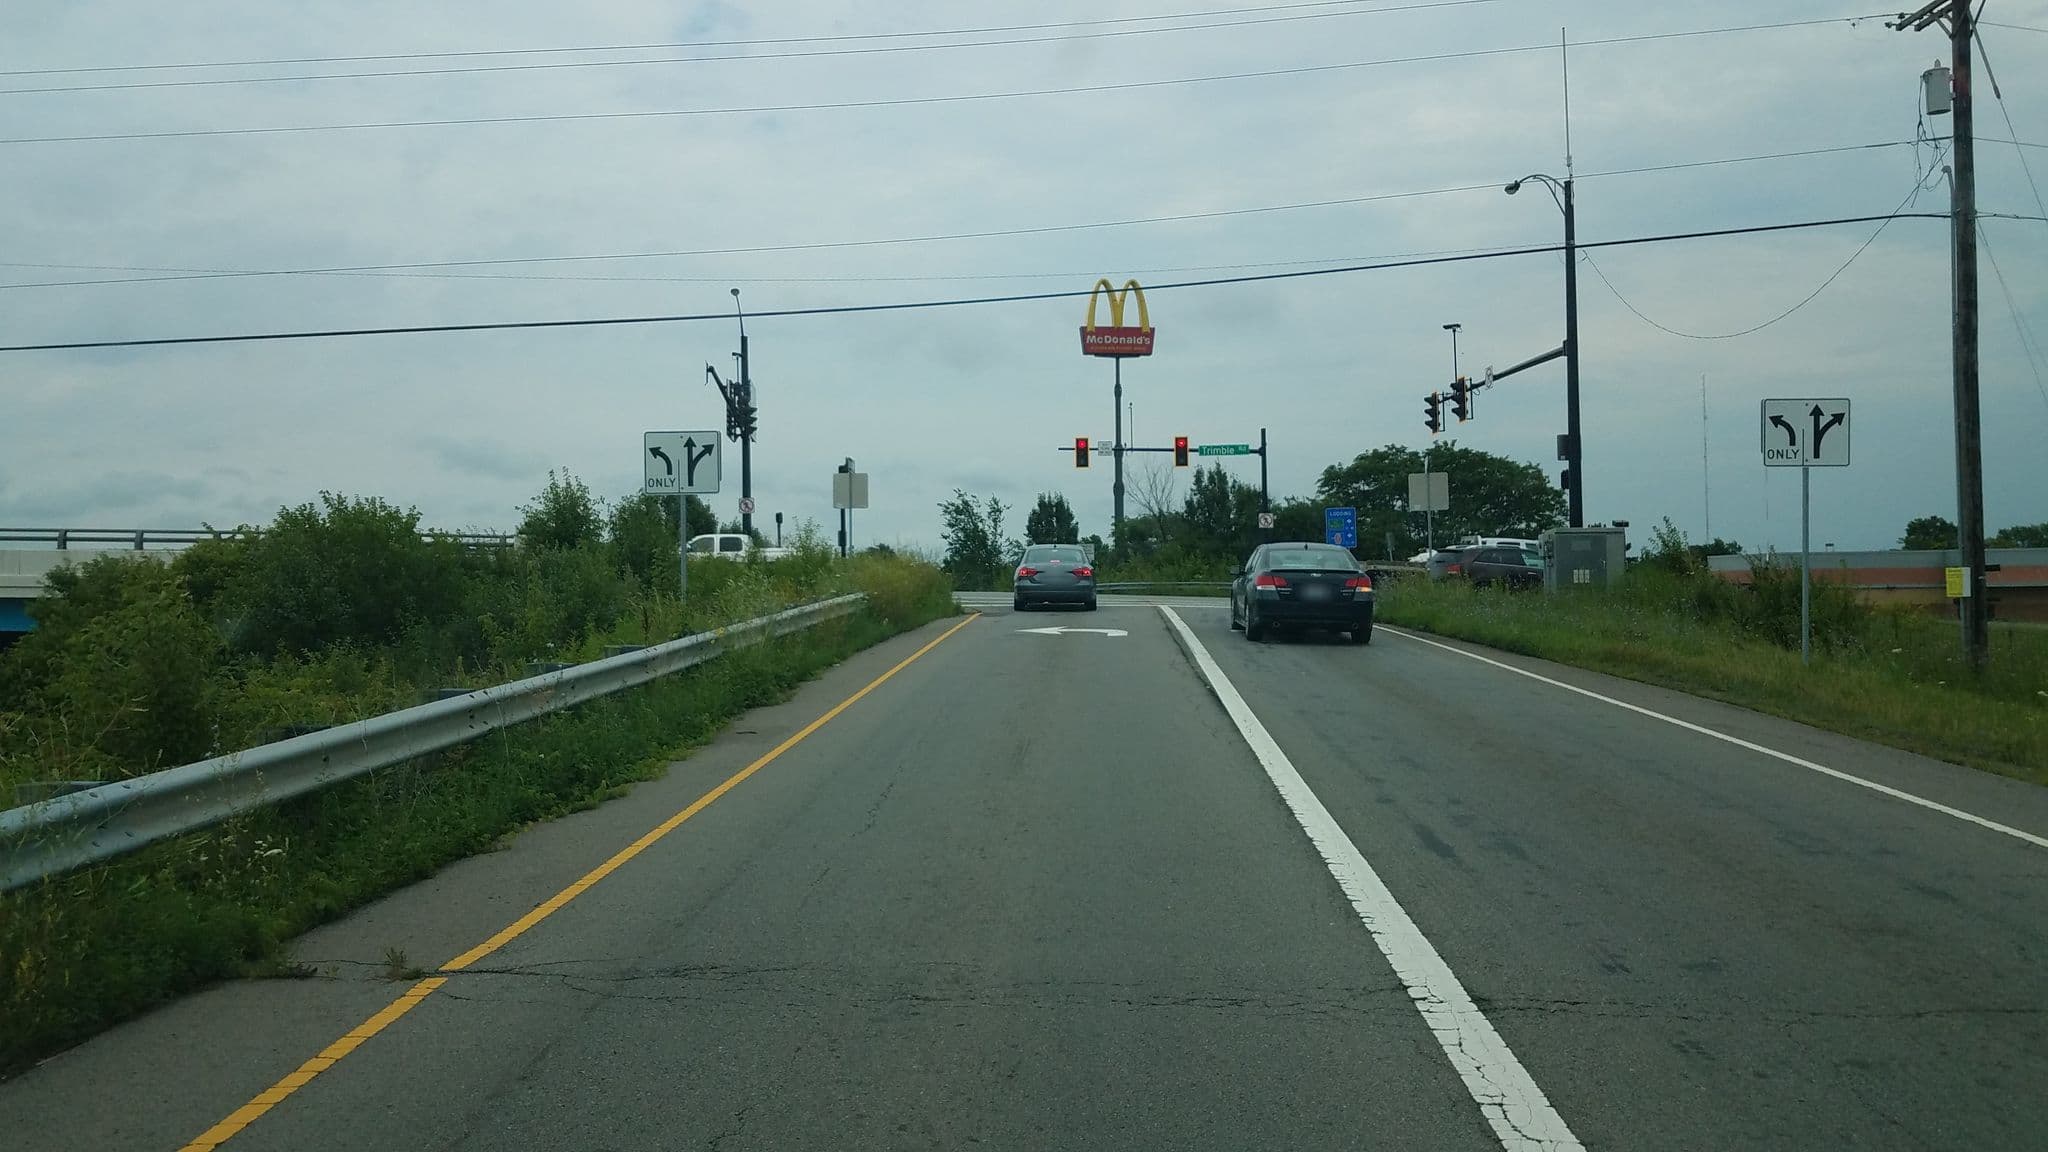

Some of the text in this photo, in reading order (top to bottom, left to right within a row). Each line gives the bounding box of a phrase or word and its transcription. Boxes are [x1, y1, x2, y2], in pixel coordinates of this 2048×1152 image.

[1086, 335, 1151, 345] McDonald's
[1202, 446, 1235, 455] Trimble
[1767, 449, 1800, 460] ONLY
[648, 478, 676, 488] ONLY
